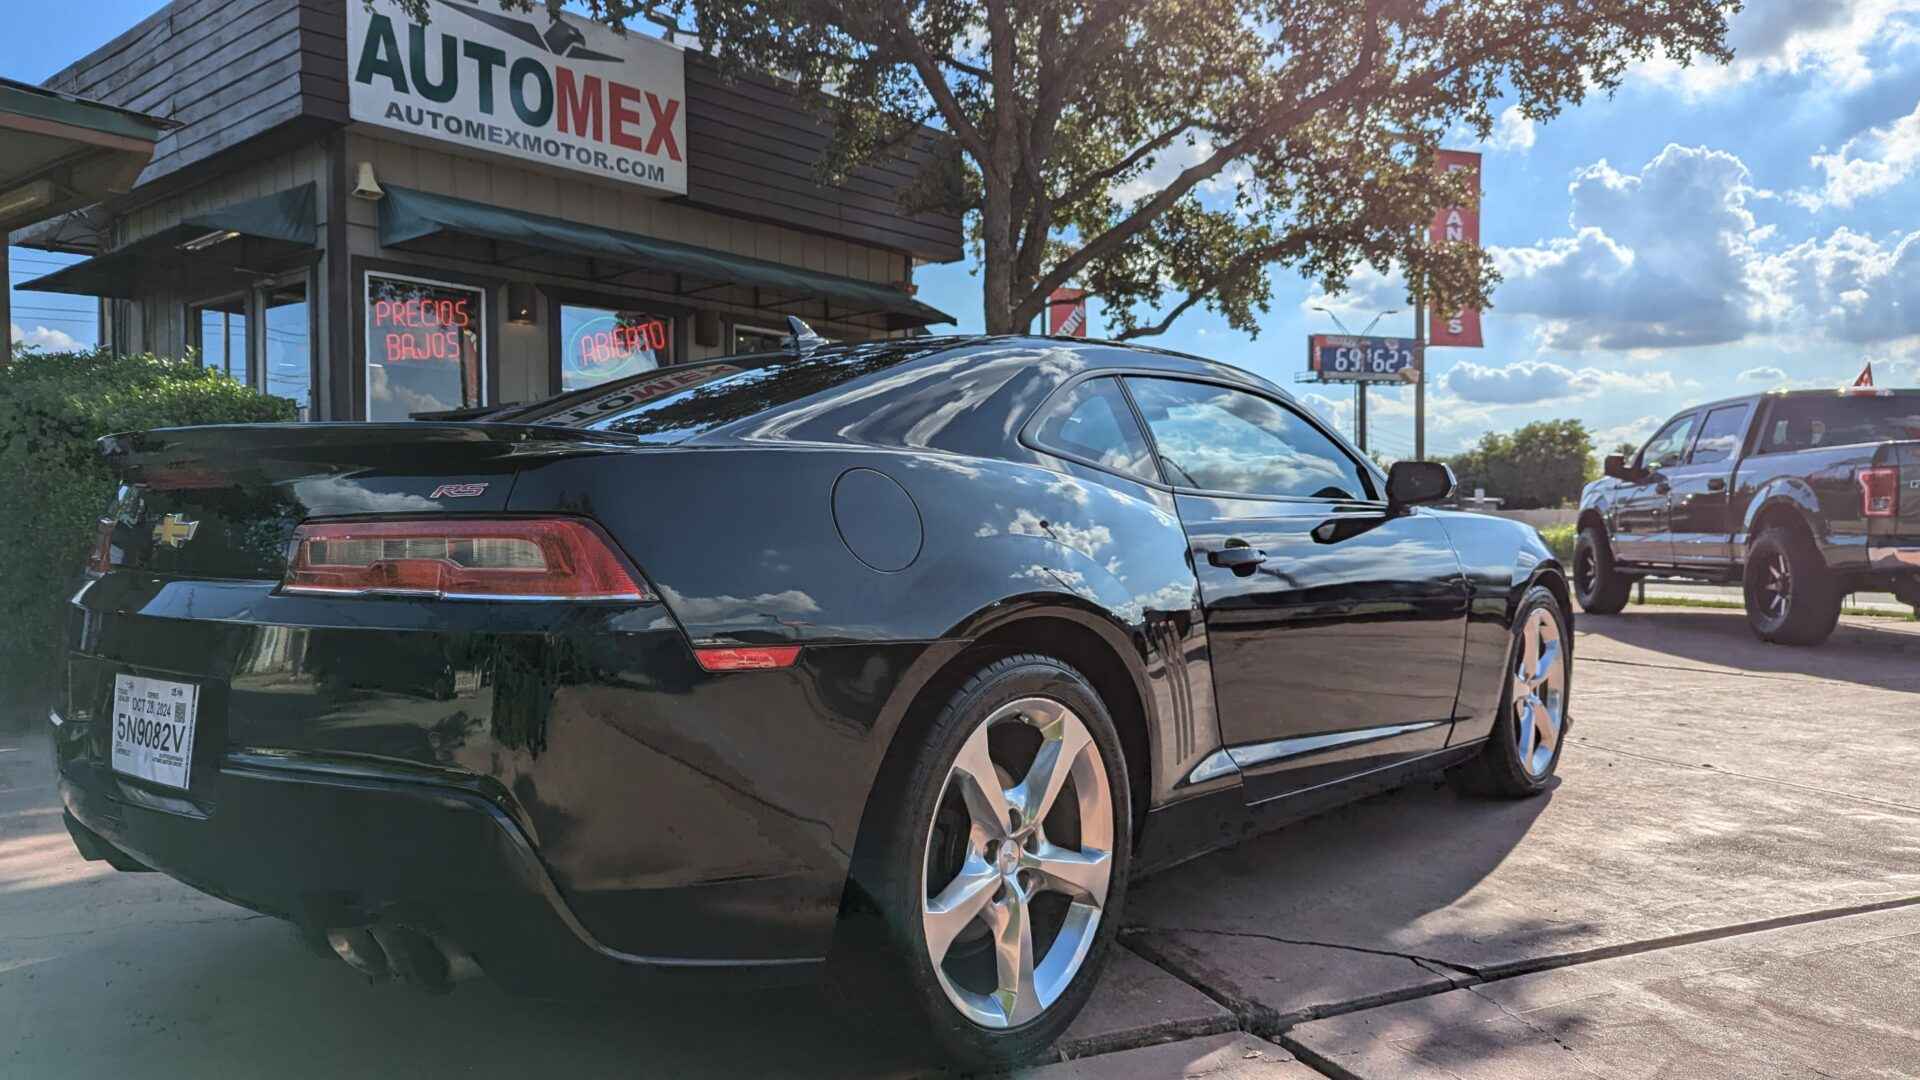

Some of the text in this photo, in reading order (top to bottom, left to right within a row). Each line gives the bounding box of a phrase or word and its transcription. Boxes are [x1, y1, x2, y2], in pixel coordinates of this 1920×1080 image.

[355, 12, 682, 162] AUTOMEX
[384, 101, 665, 182] AUTOMEXMOTOR.COM
[374, 299, 470, 327] PRECIOS
[386, 331, 460, 361] BAJOS
[580, 320, 665, 367] ABIERTO
[430, 482, 489, 499] RS
[132, 697, 146, 712] OCT
[157, 702, 171, 717] 2024
[117, 713, 186, 753] 5N9082V
